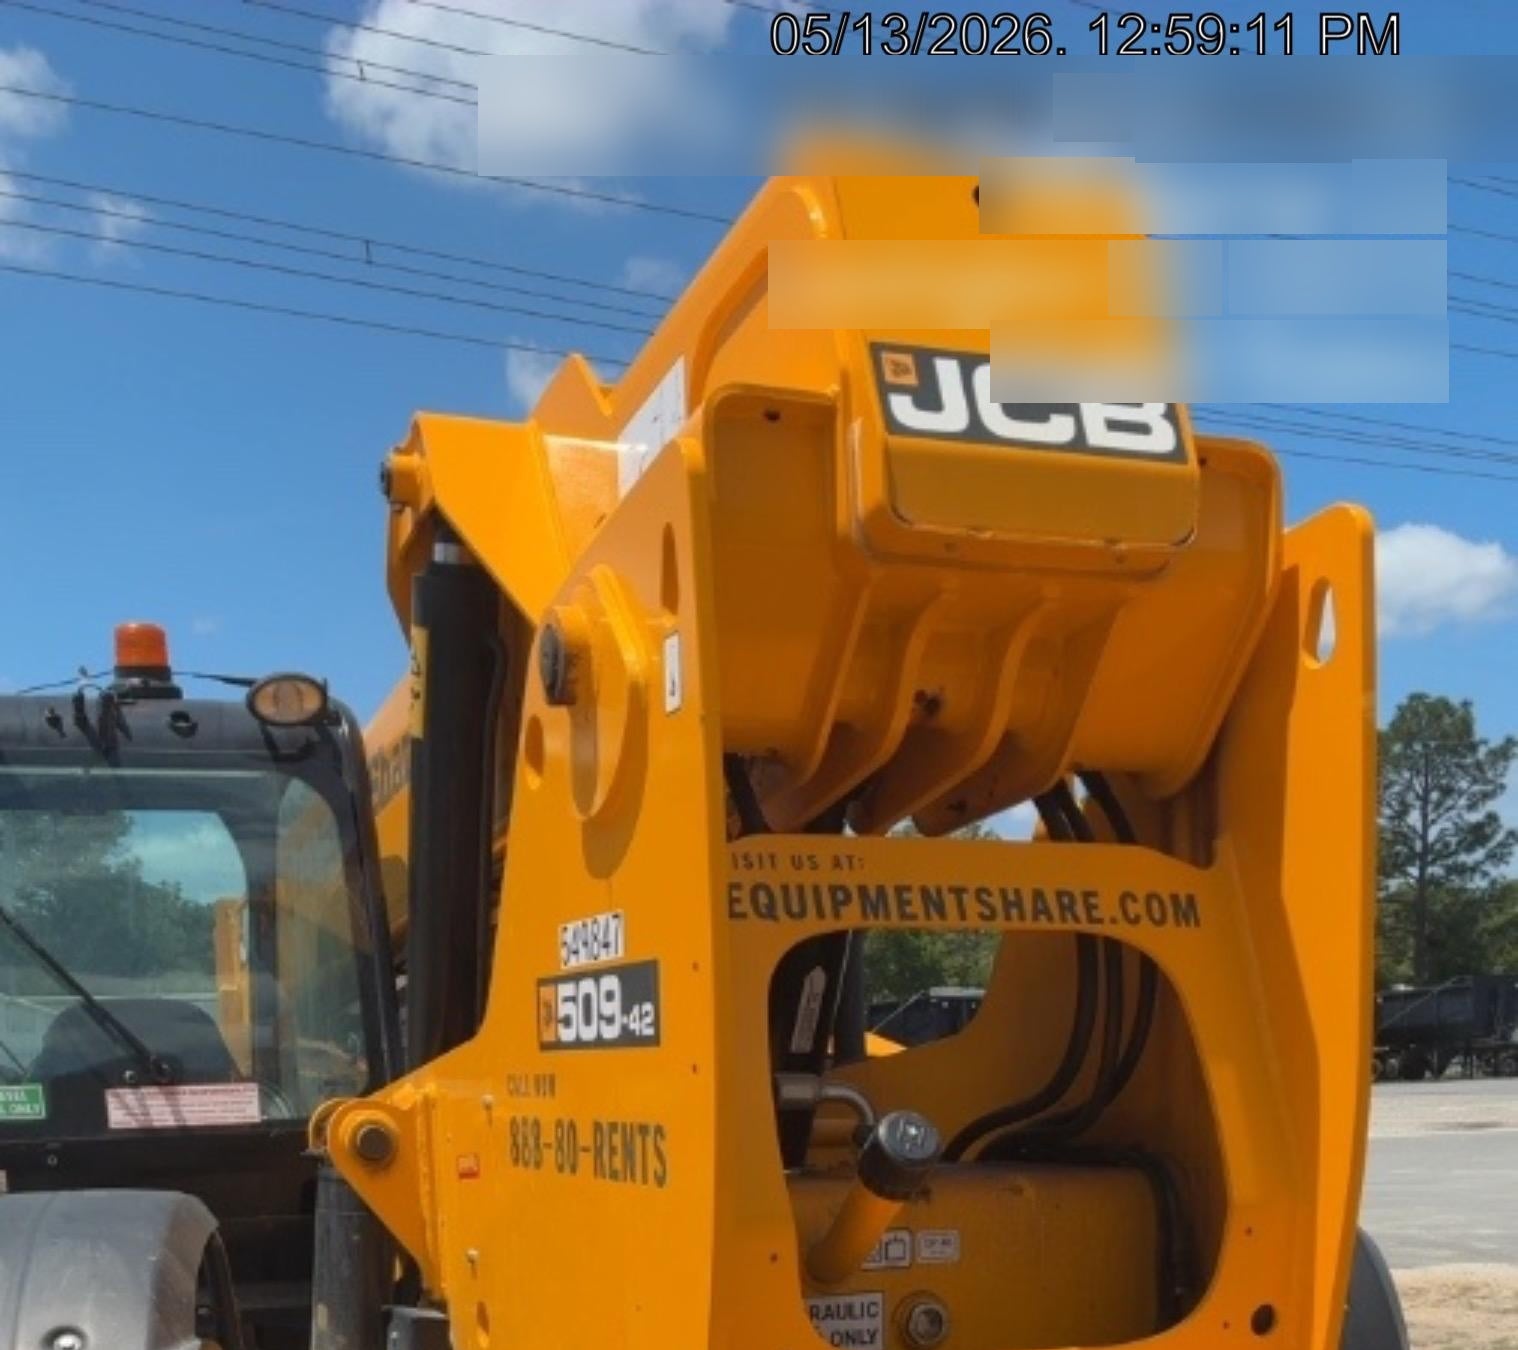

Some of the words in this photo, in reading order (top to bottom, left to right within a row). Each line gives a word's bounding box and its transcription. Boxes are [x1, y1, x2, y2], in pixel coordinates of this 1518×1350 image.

[888, 356, 1177, 453] JCB
[731, 851, 776, 871] ISIT
[790, 853, 819, 871] US
[831, 854, 864, 871] AT:
[727, 881, 1201, 928] EQUIPMENTSHARE.COM
[560, 912, 621, 966] 549847
[557, 974, 656, 1042] 509-42
[509, 1115, 667, 1189] 888-80-RENTS
[809, 1302, 879, 1321] RAULIC
[830, 1328, 878, 1348] ONLY
